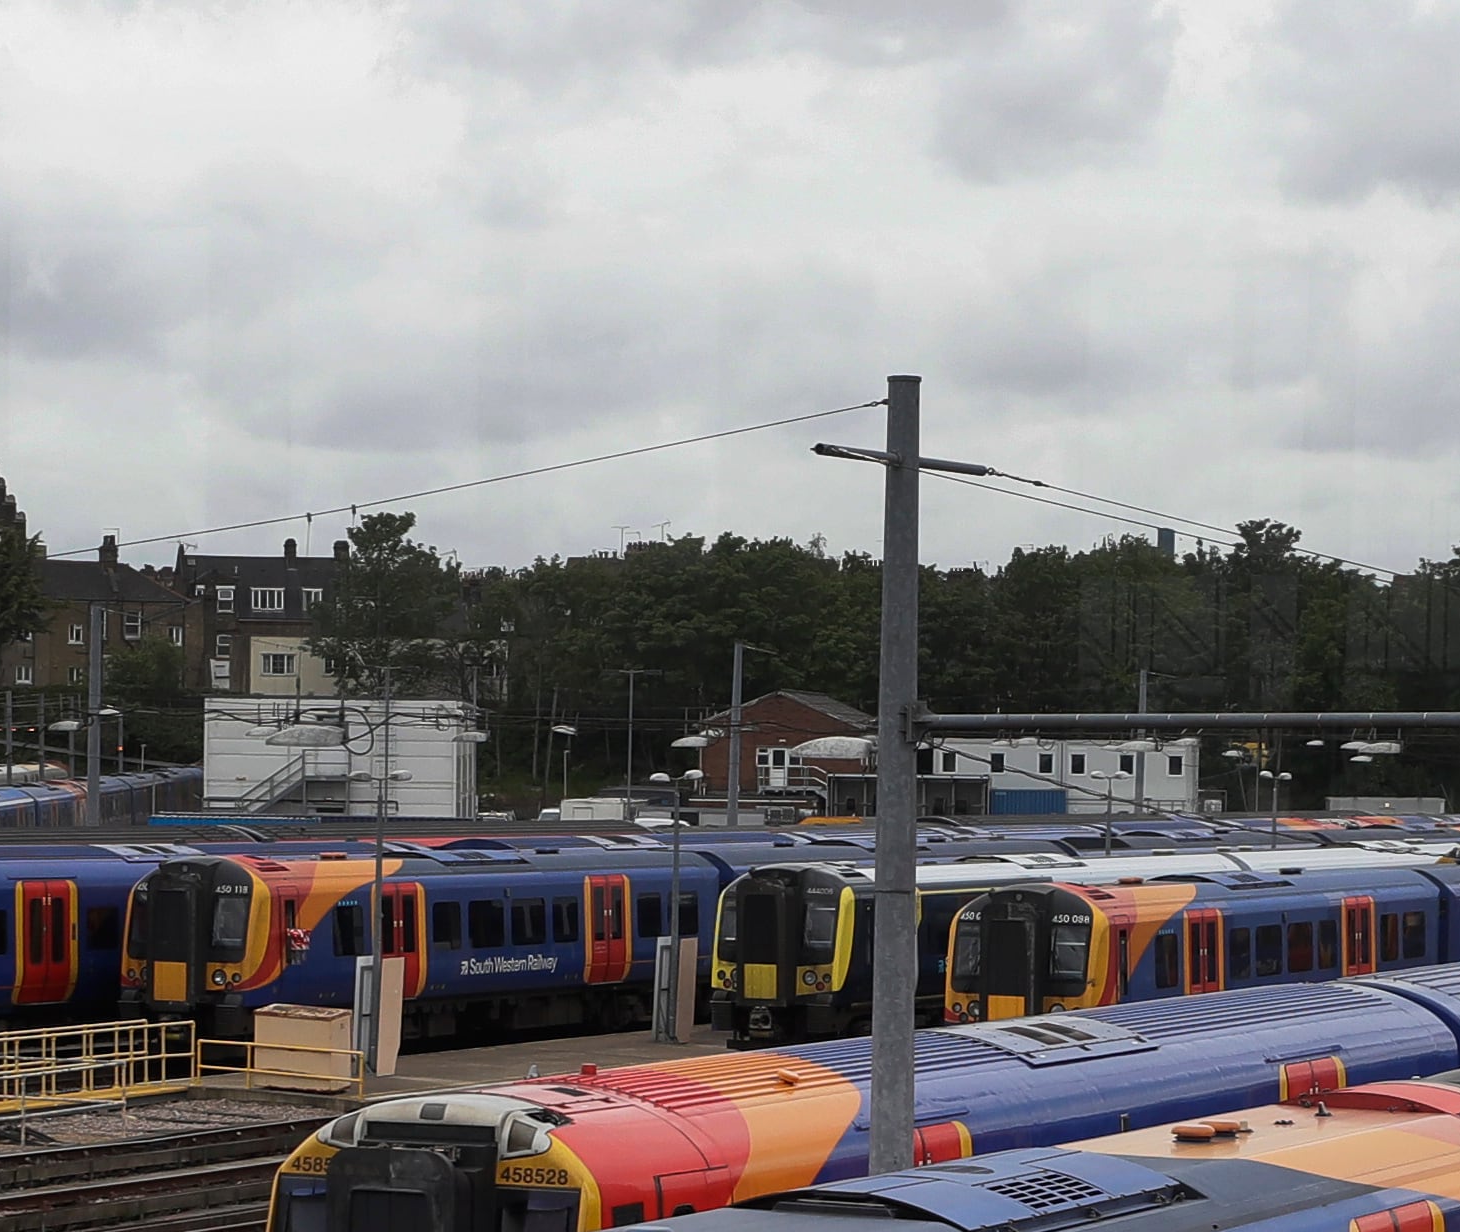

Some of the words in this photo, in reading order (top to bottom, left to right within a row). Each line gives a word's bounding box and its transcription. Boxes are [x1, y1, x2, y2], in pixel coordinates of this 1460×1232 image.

[1051, 914, 1070, 924] 450
[469, 957, 494, 975] South
[494, 956, 527, 974] Western
[527, 953, 558, 974] Railway
[291, 1156, 331, 1174] 4585
[500, 1166, 569, 1186] 458528
